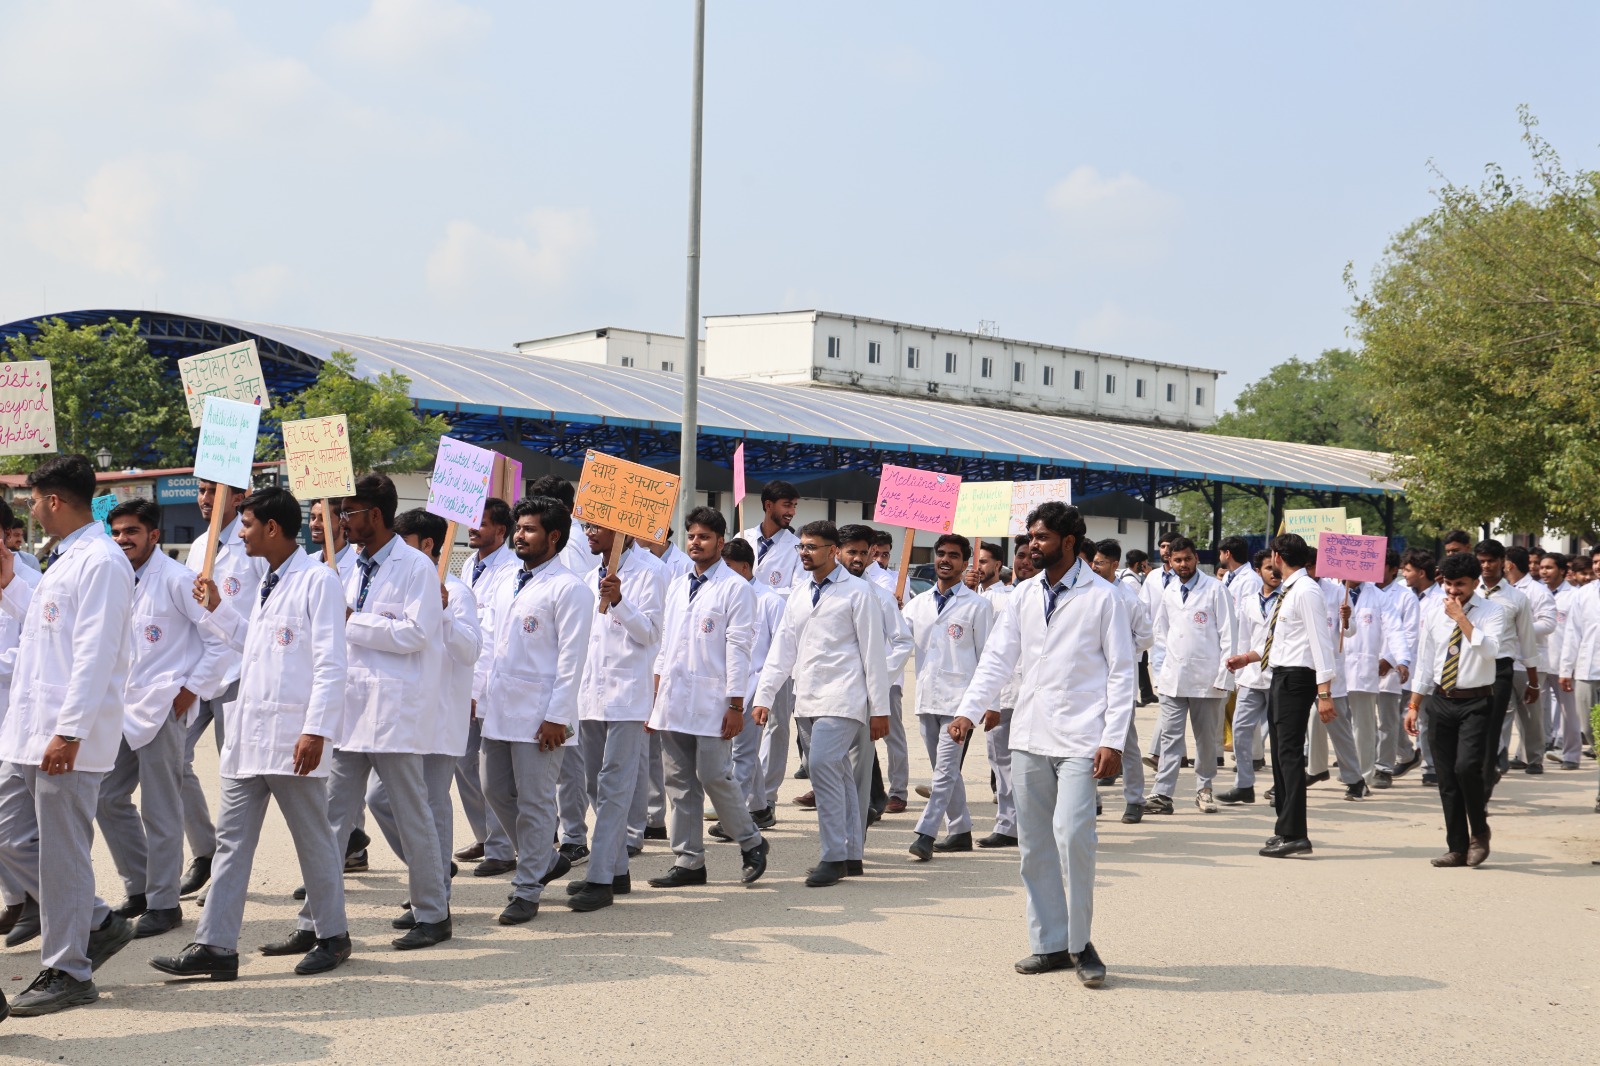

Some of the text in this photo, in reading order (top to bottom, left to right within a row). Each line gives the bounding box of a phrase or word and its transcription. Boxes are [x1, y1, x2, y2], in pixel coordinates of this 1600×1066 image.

[433, 465, 461, 490] behind
[623, 472, 665, 494] उपचार
[161, 488, 199, 498] MOTORC
[589, 482, 616, 502] करती
[631, 489, 670, 515] निगरानी
[584, 498, 617, 522] सुरक्षा
[617, 508, 645, 529] करती
